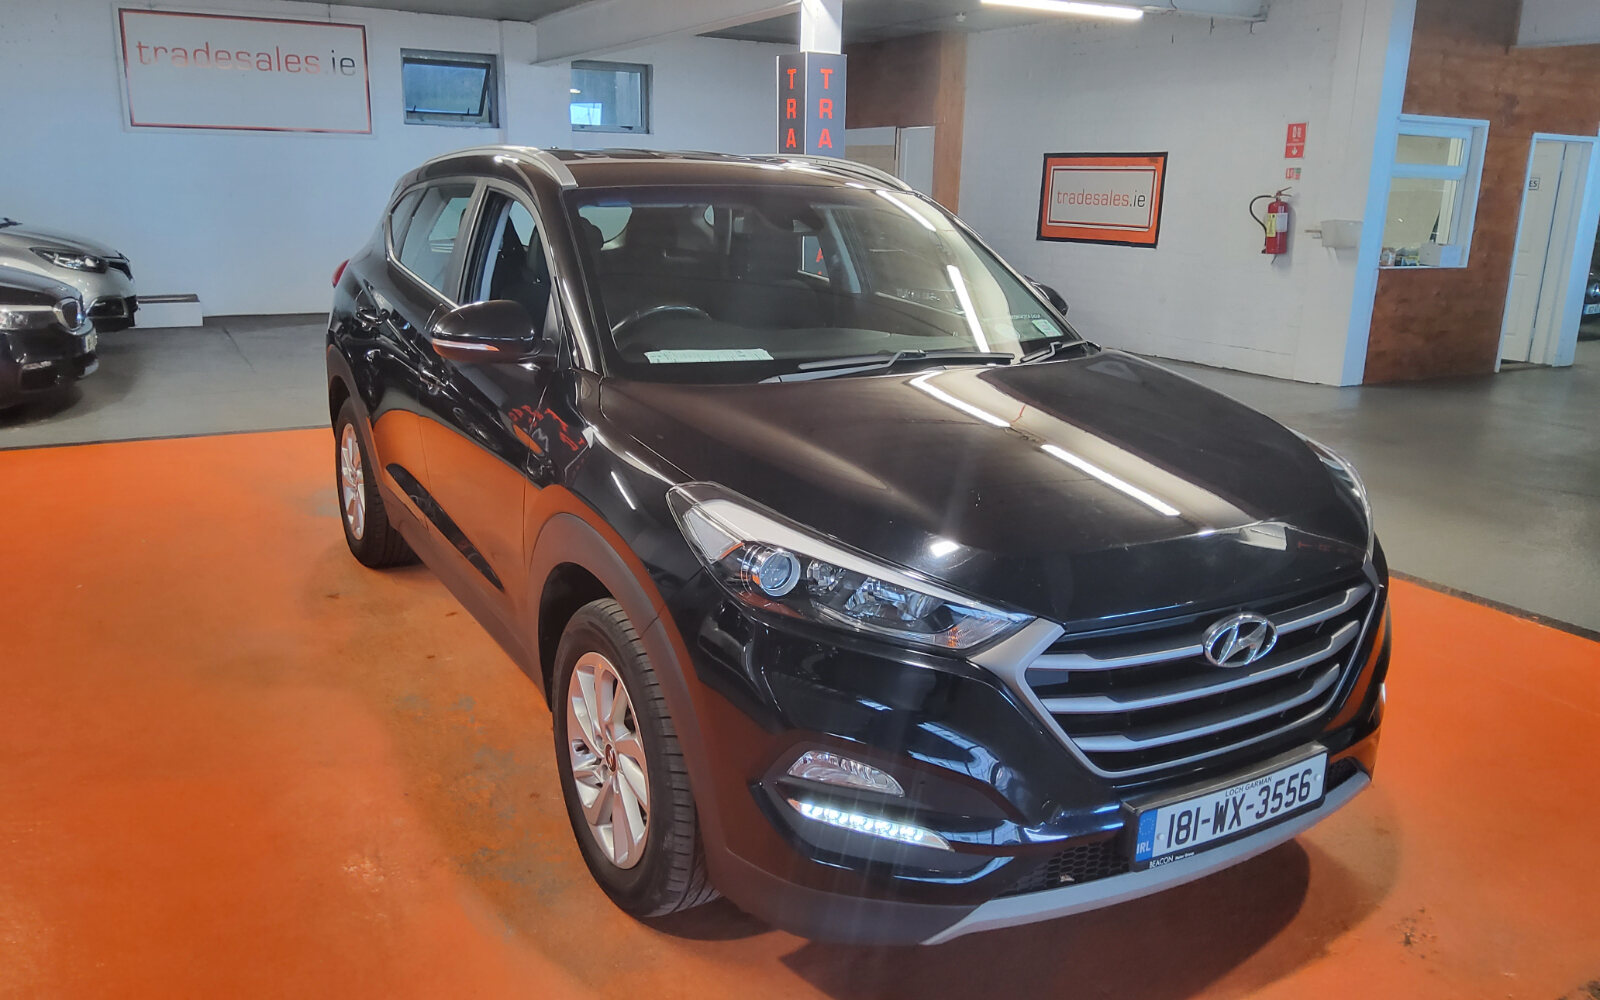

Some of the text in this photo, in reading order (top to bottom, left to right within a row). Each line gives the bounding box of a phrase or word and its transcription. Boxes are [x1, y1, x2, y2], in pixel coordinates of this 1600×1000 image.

[136, 41, 357, 76] tradesales.ie
[1057, 188, 1146, 207] tradesales.ie
[1225, 776, 1272, 797] LOCH GARMAN
[1166, 767, 1313, 849] 181-WX-3556
[1136, 841, 1151, 855] IRL
[1149, 854, 1174, 869] BEACON
